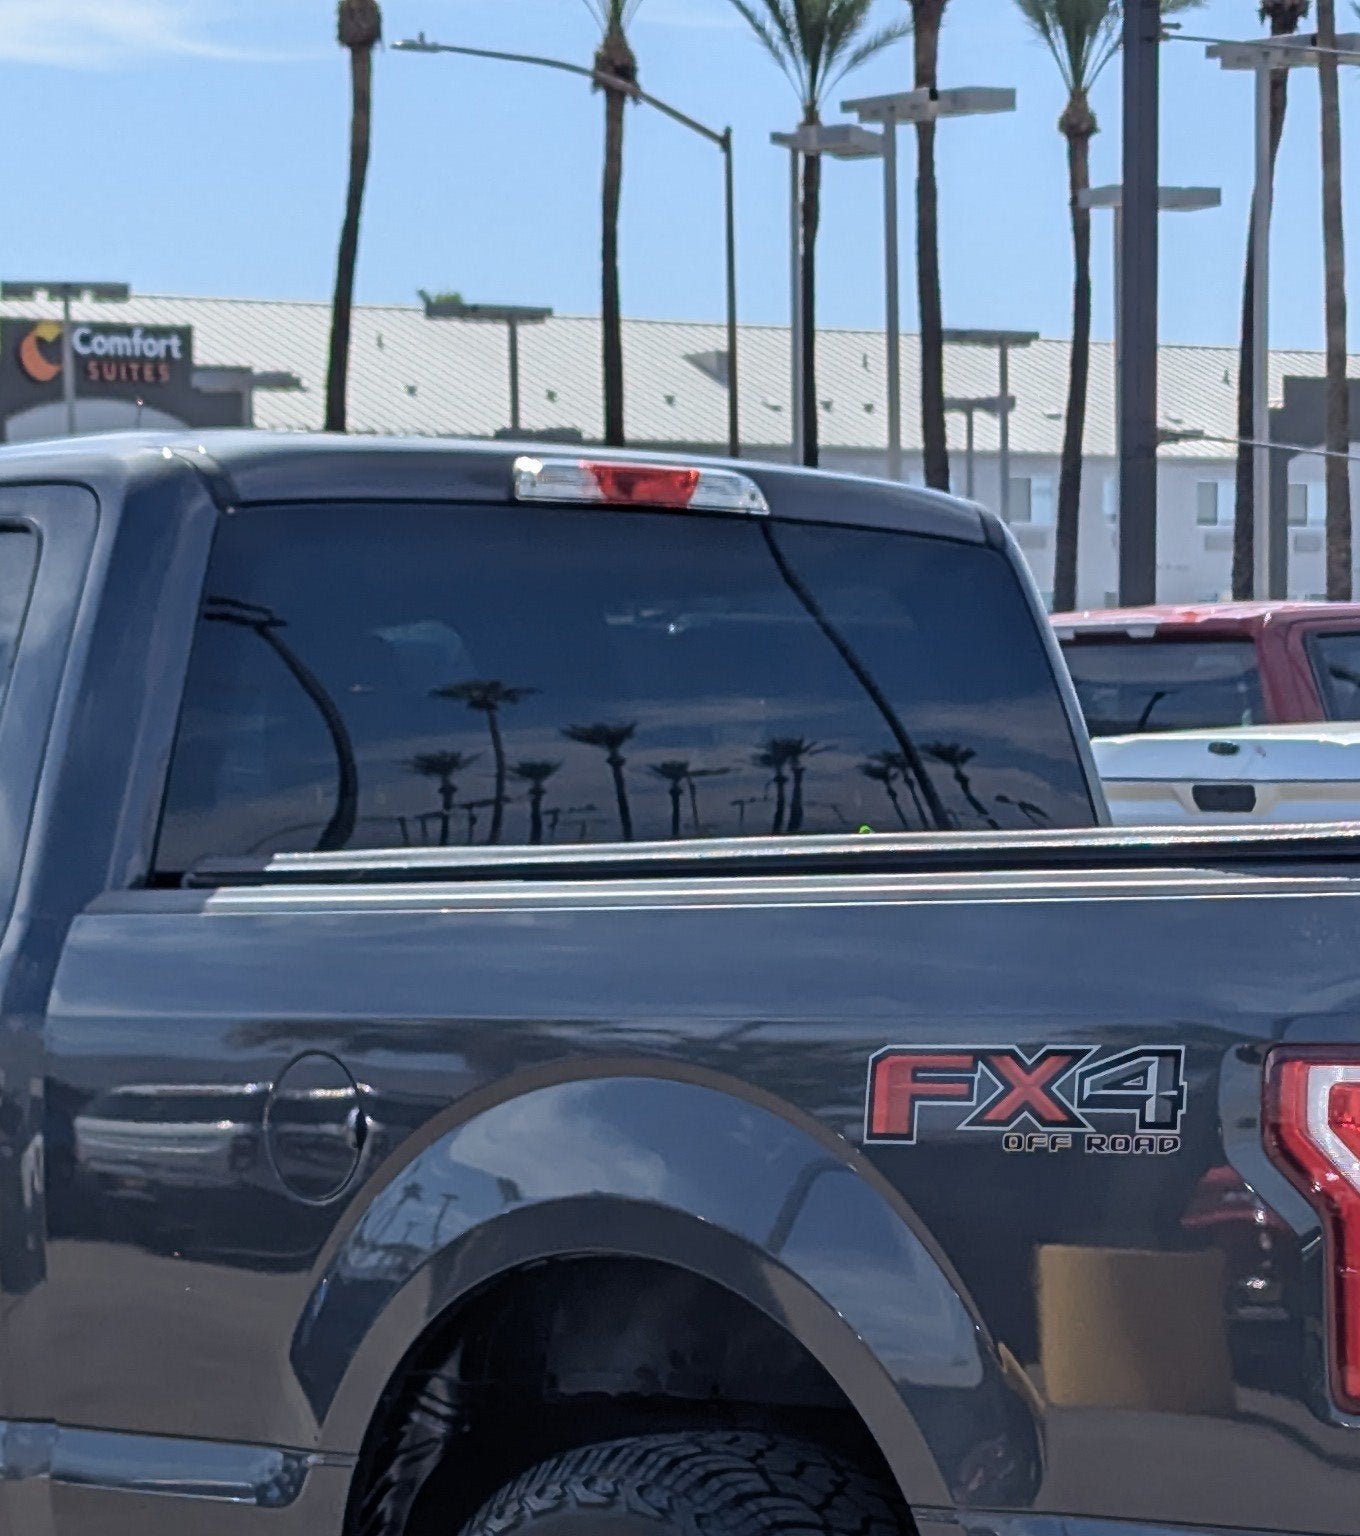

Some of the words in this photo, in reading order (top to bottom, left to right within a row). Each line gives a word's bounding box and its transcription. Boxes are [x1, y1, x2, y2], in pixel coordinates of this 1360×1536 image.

[72, 325, 182, 360] Comfort
[88, 360, 170, 382] SUITES
[863, 1044, 1188, 1145] FX4
[1002, 1133, 1072, 1153] OFF
[1085, 1134, 1181, 1155] ROAD
